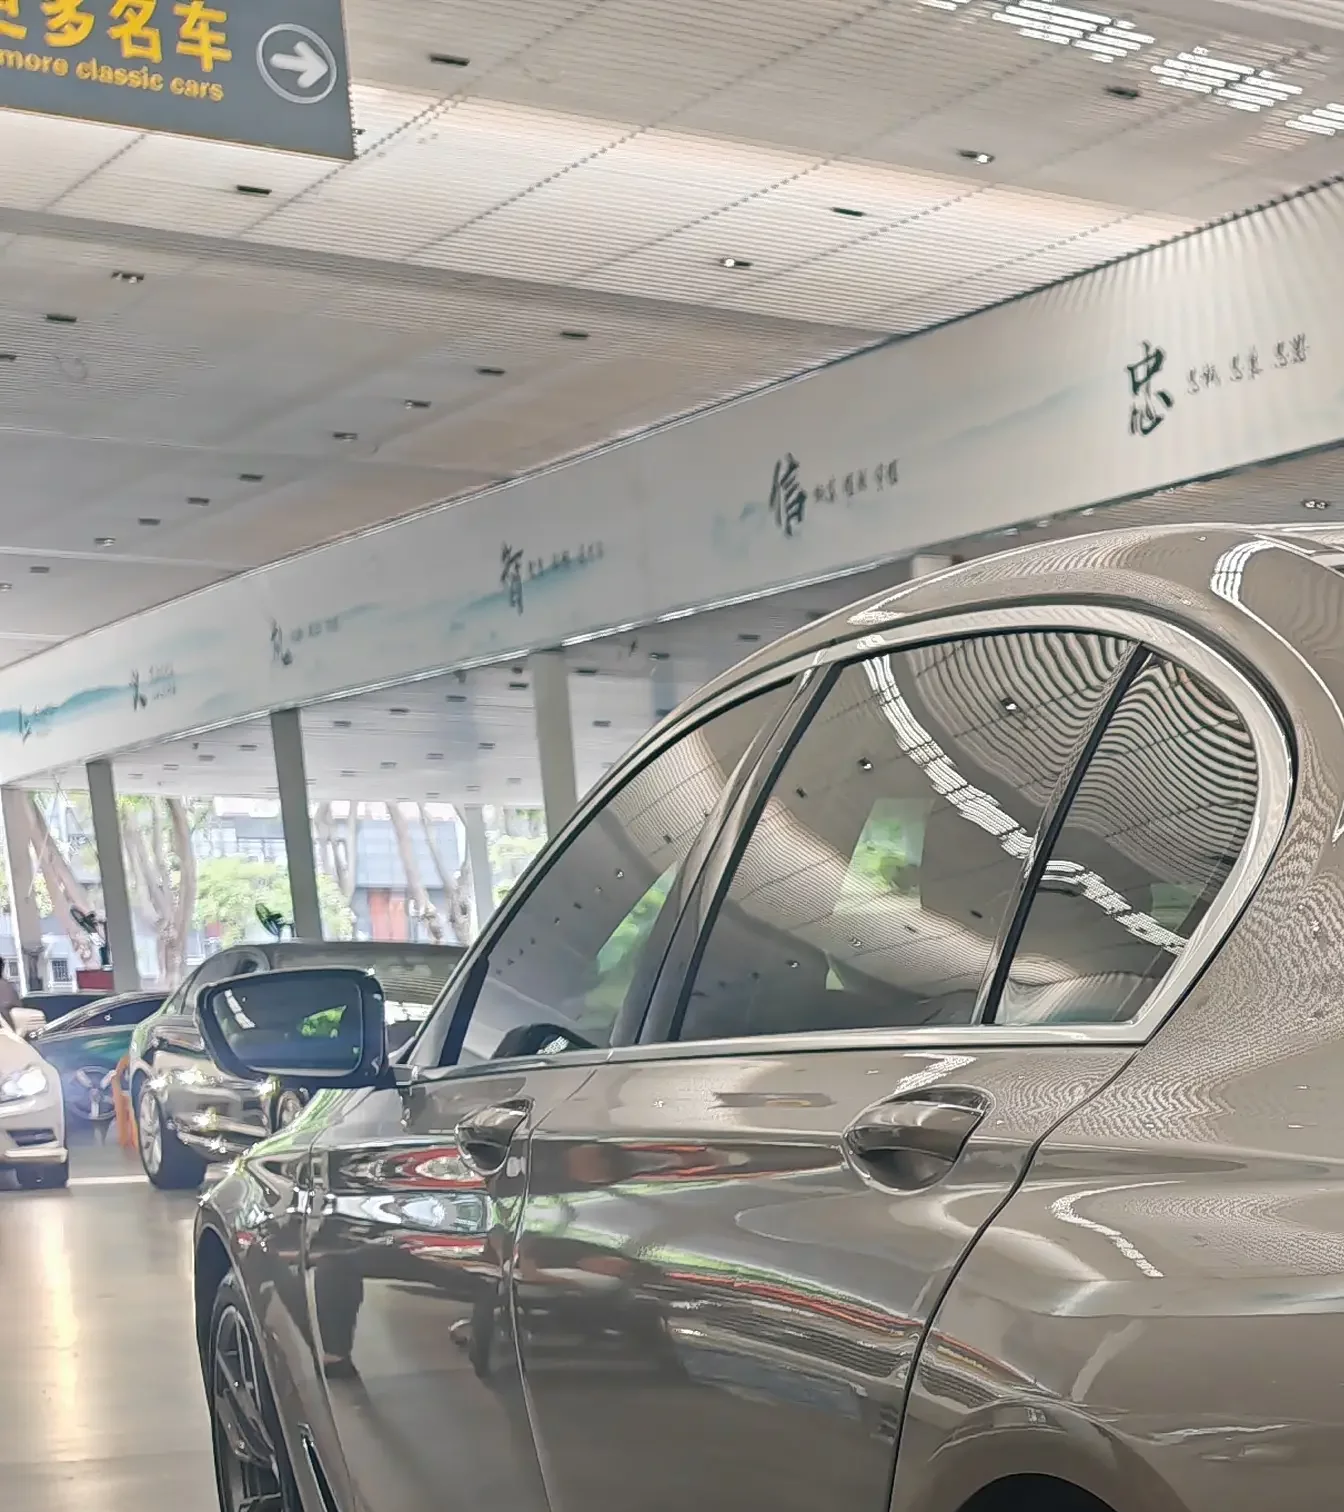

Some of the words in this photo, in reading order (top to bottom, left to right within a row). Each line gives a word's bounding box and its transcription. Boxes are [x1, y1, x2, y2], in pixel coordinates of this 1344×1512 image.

[76, 57, 165, 92] classic
[169, 78, 225, 102] cars
[1127, 340, 1174, 434] 忠
